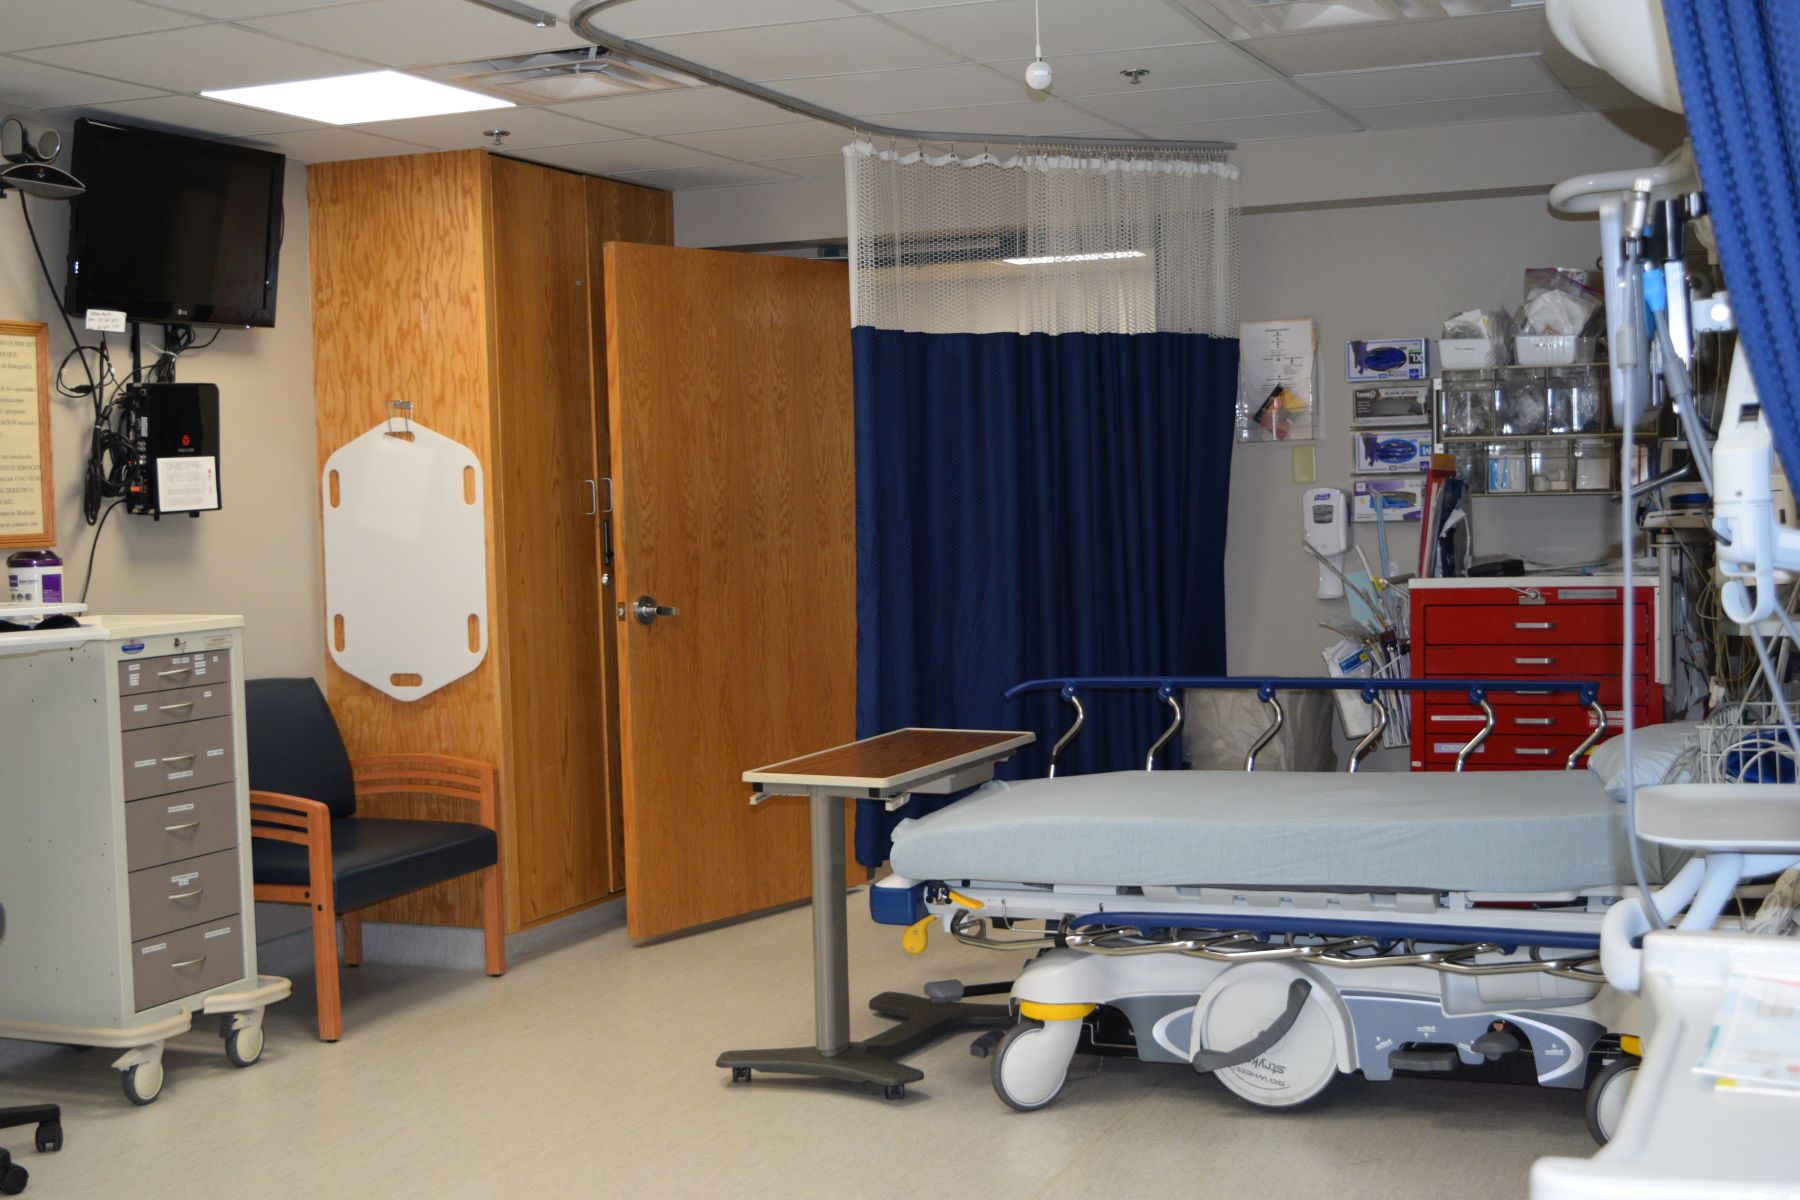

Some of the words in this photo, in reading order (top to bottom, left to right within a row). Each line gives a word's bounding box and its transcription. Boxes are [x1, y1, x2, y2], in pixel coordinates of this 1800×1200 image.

[1410, 353, 1423, 362] XL
[1251, 1058, 1286, 1074] stryk
[1269, 1079, 1285, 1087] BIG
